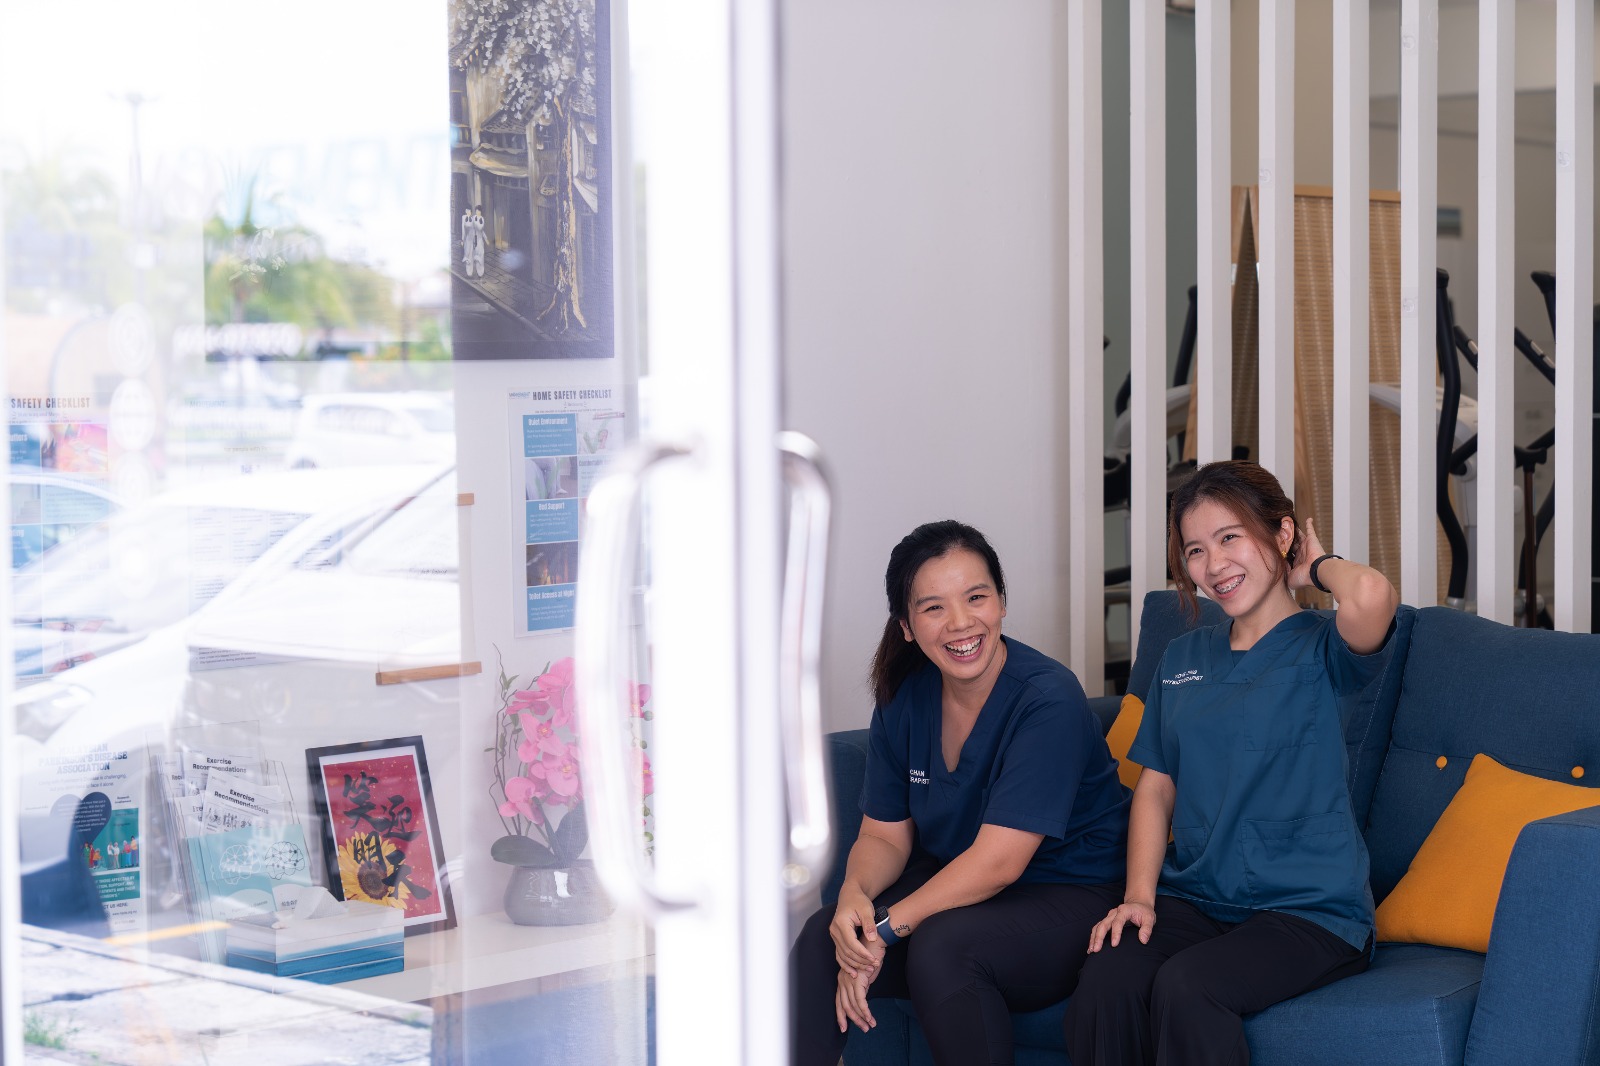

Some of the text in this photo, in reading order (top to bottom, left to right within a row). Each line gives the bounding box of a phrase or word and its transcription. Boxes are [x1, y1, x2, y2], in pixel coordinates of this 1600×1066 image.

[532, 391, 552, 401] HOME
[554, 390, 577, 400] SAFETY
[579, 389, 613, 399] CHECKLIST
[10, 397, 91, 409] SAFETY CHECKLIST
[547, 501, 565, 511] Support
[94, 750, 128, 762] DISEASE
[206, 757, 232, 766] Exercise
[56, 761, 111, 775] ASSOCIATION
[229, 788, 255, 804] Exercise
[214, 790, 270, 815] Recommendations
